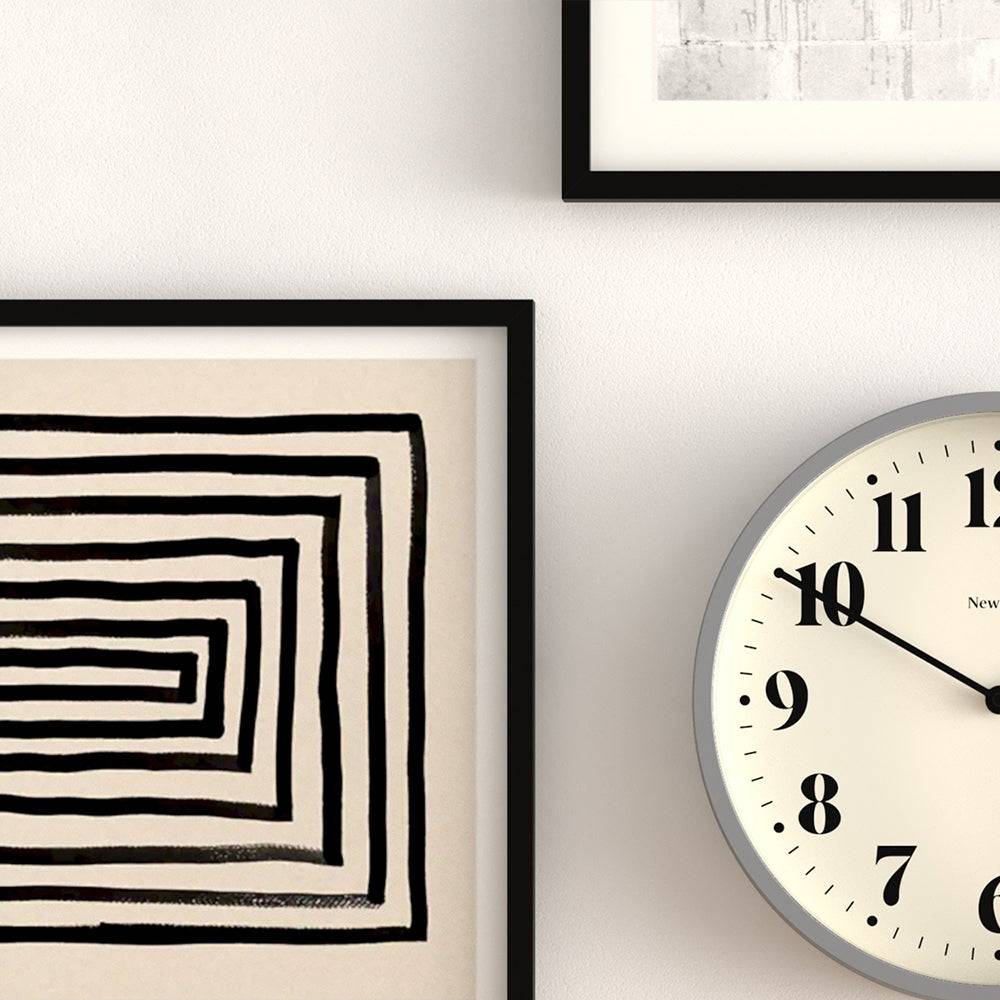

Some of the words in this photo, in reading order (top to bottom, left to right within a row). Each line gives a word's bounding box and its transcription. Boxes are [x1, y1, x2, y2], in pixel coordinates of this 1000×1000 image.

[872, 491, 926, 553] 11
[794, 561, 866, 627] 10
[765, 669, 809, 731] 9
[798, 773, 842, 835] 8
[875, 845, 918, 907] 7
